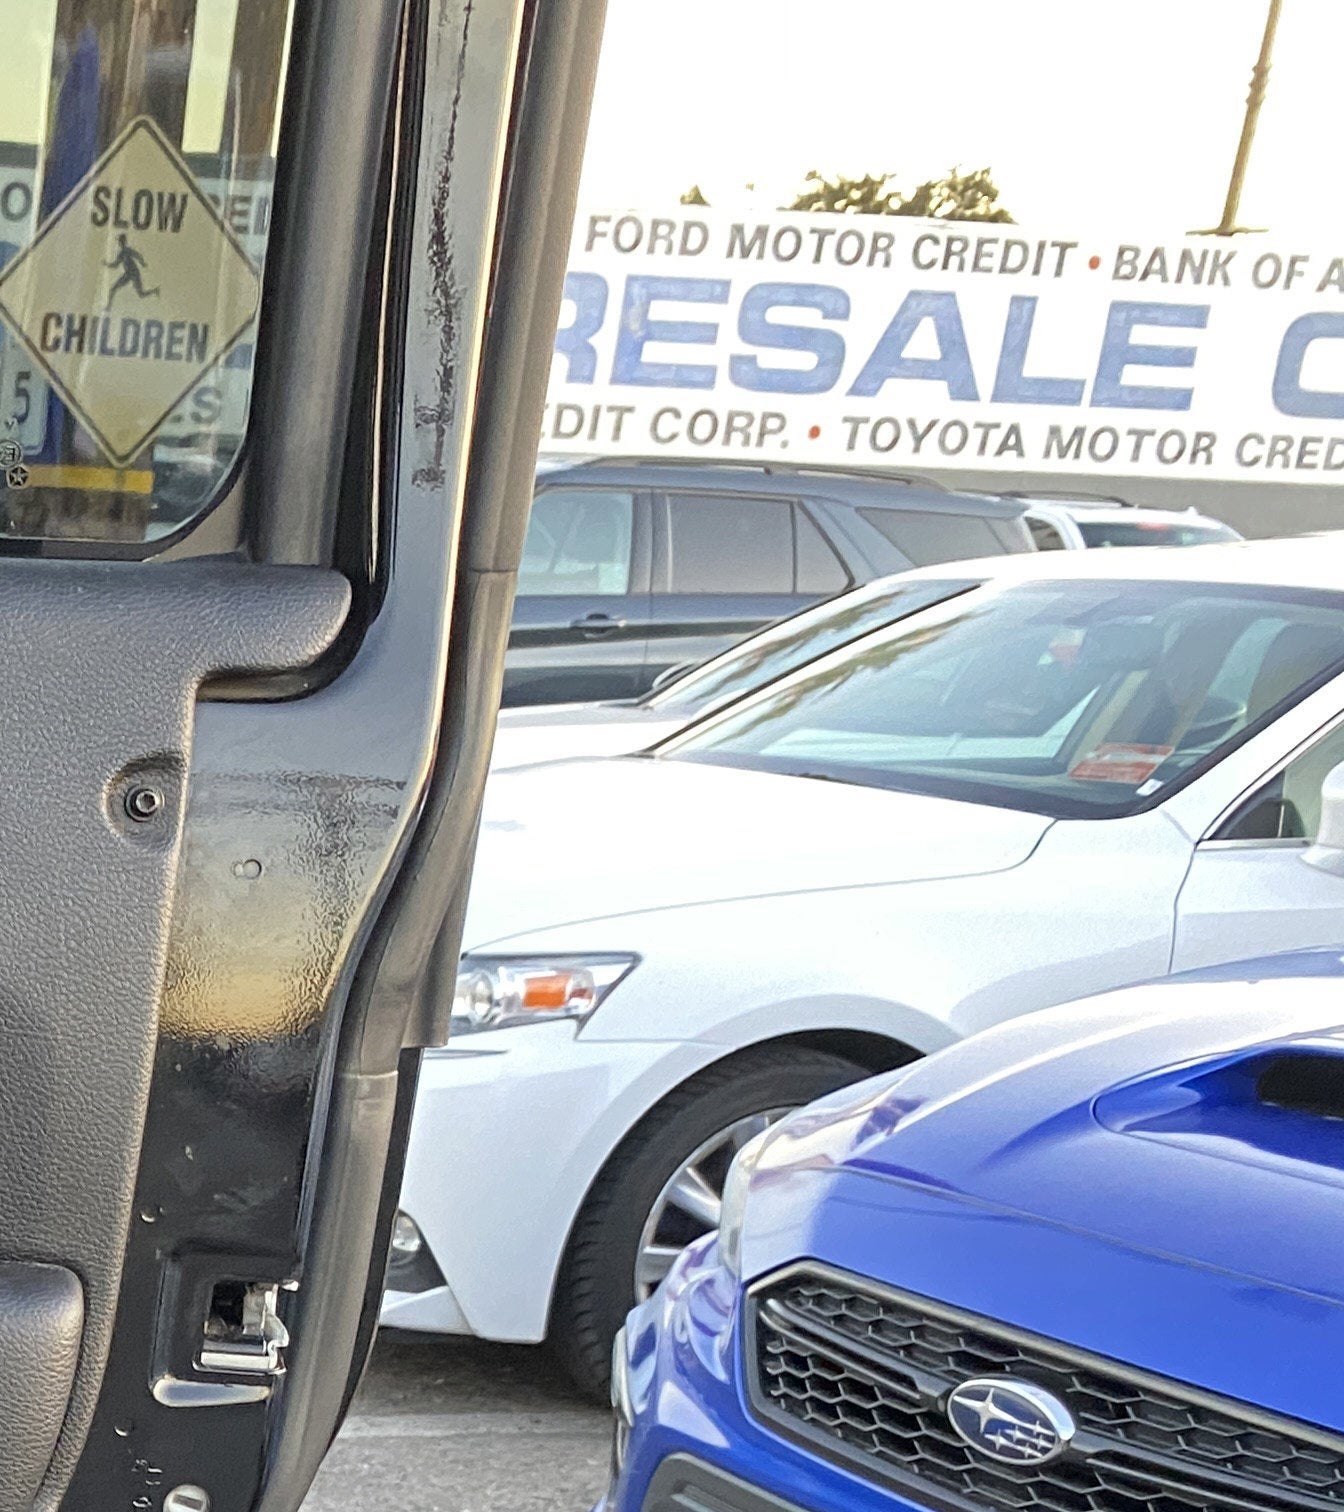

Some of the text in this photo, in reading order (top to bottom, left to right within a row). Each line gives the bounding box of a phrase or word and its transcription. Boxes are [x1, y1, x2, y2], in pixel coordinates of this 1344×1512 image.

[90, 185, 188, 234] SLOW
[584, 215, 710, 256] FORD
[727, 224, 897, 269] MOTOR
[912, 233, 1080, 279] CREDIT
[1111, 244, 1238, 287] BANK
[1252, 252, 1310, 290] OF
[40, 311, 210, 364] CHILDREN
[540, 402, 636, 442] DIT
[650, 406, 790, 450] CORP.
[843, 415, 1027, 460] TOYOTA
[1042, 425, 1218, 466] MOTOR
